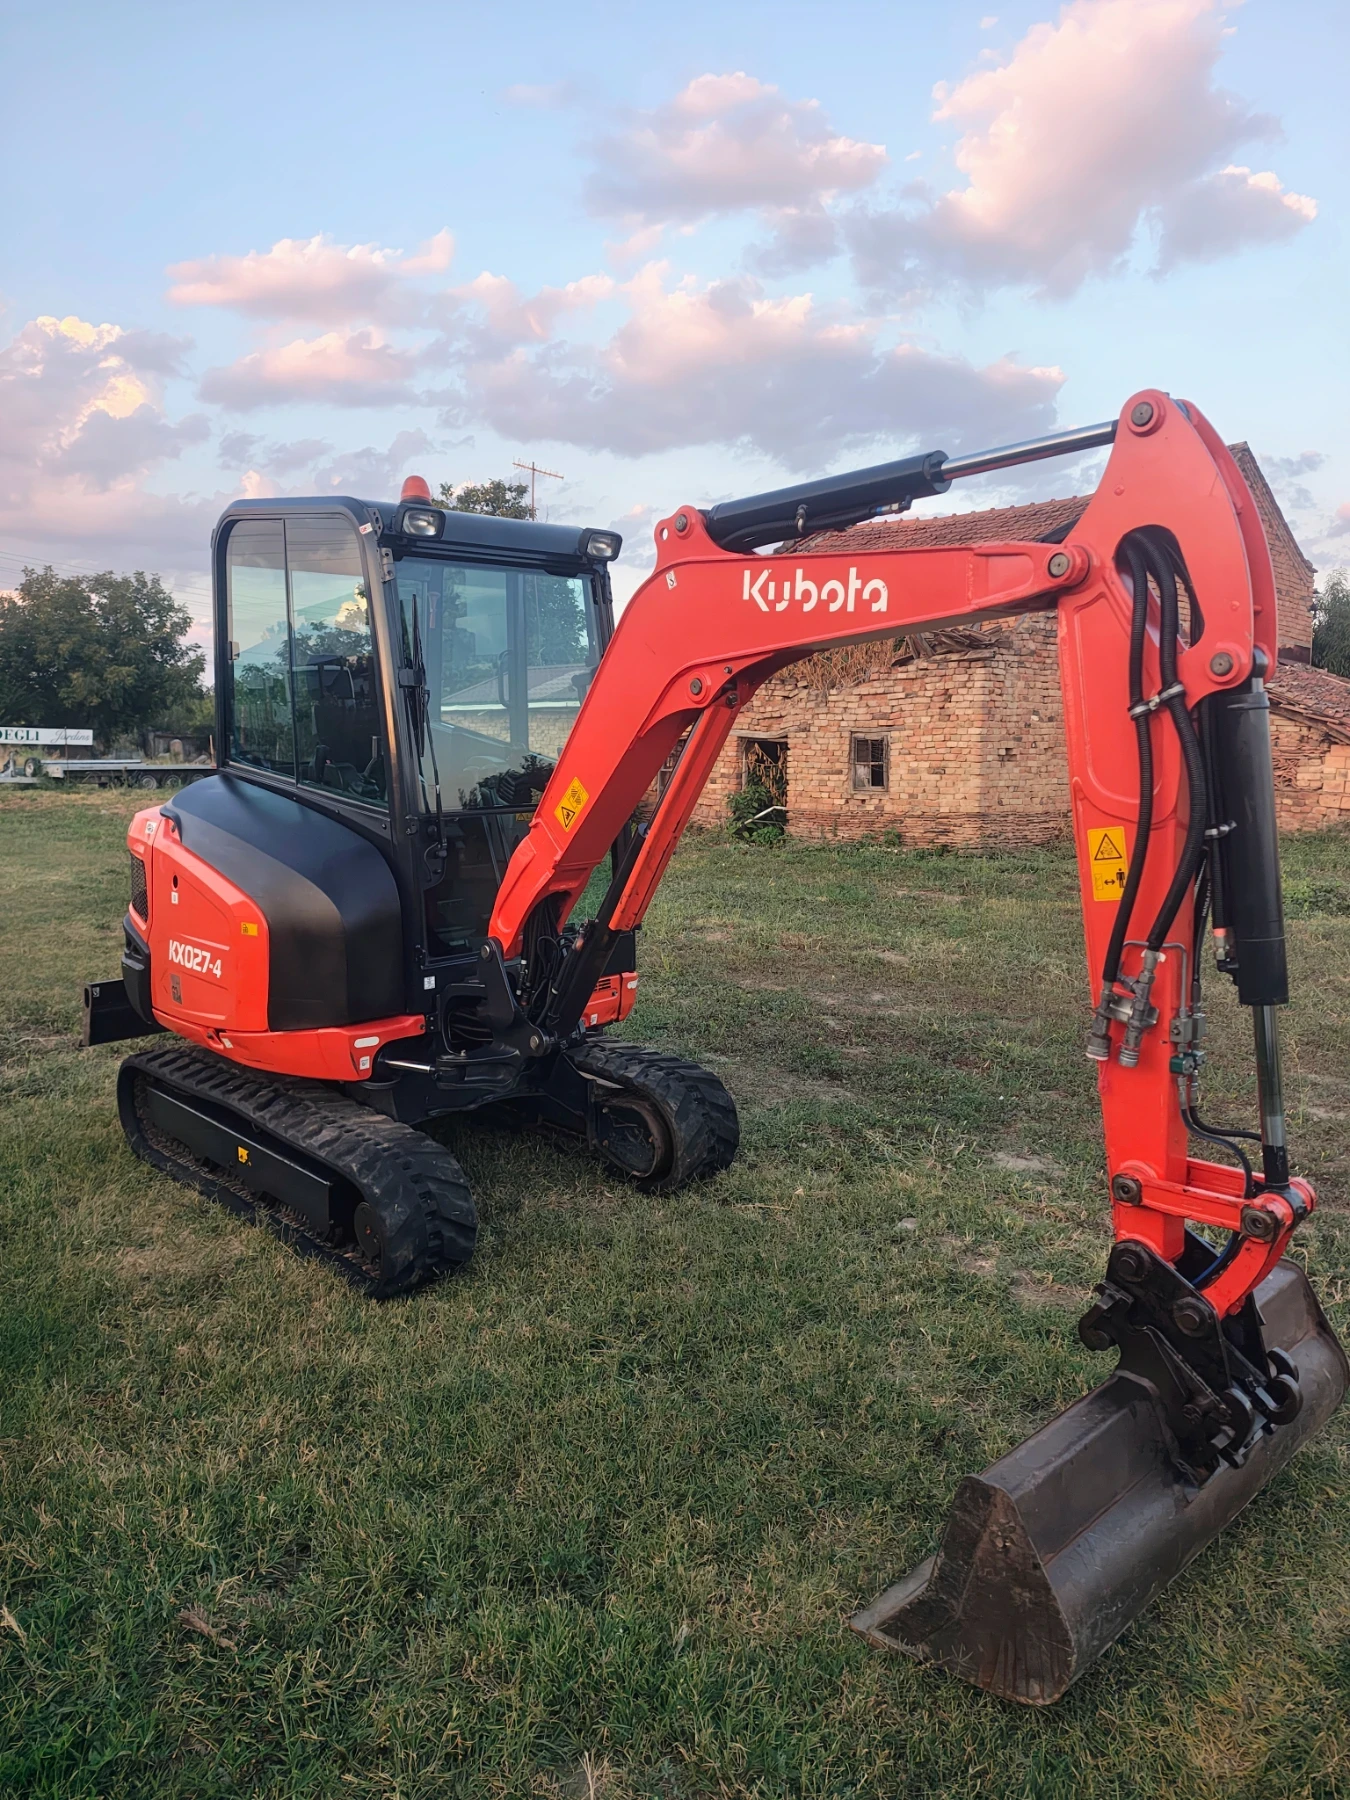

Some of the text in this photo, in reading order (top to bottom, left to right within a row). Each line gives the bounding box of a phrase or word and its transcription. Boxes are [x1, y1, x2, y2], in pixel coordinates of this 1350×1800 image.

[742, 567, 888, 612] Kubota
[0, 729, 39, 741] EGLI
[168, 939, 222, 978] KX027-4
